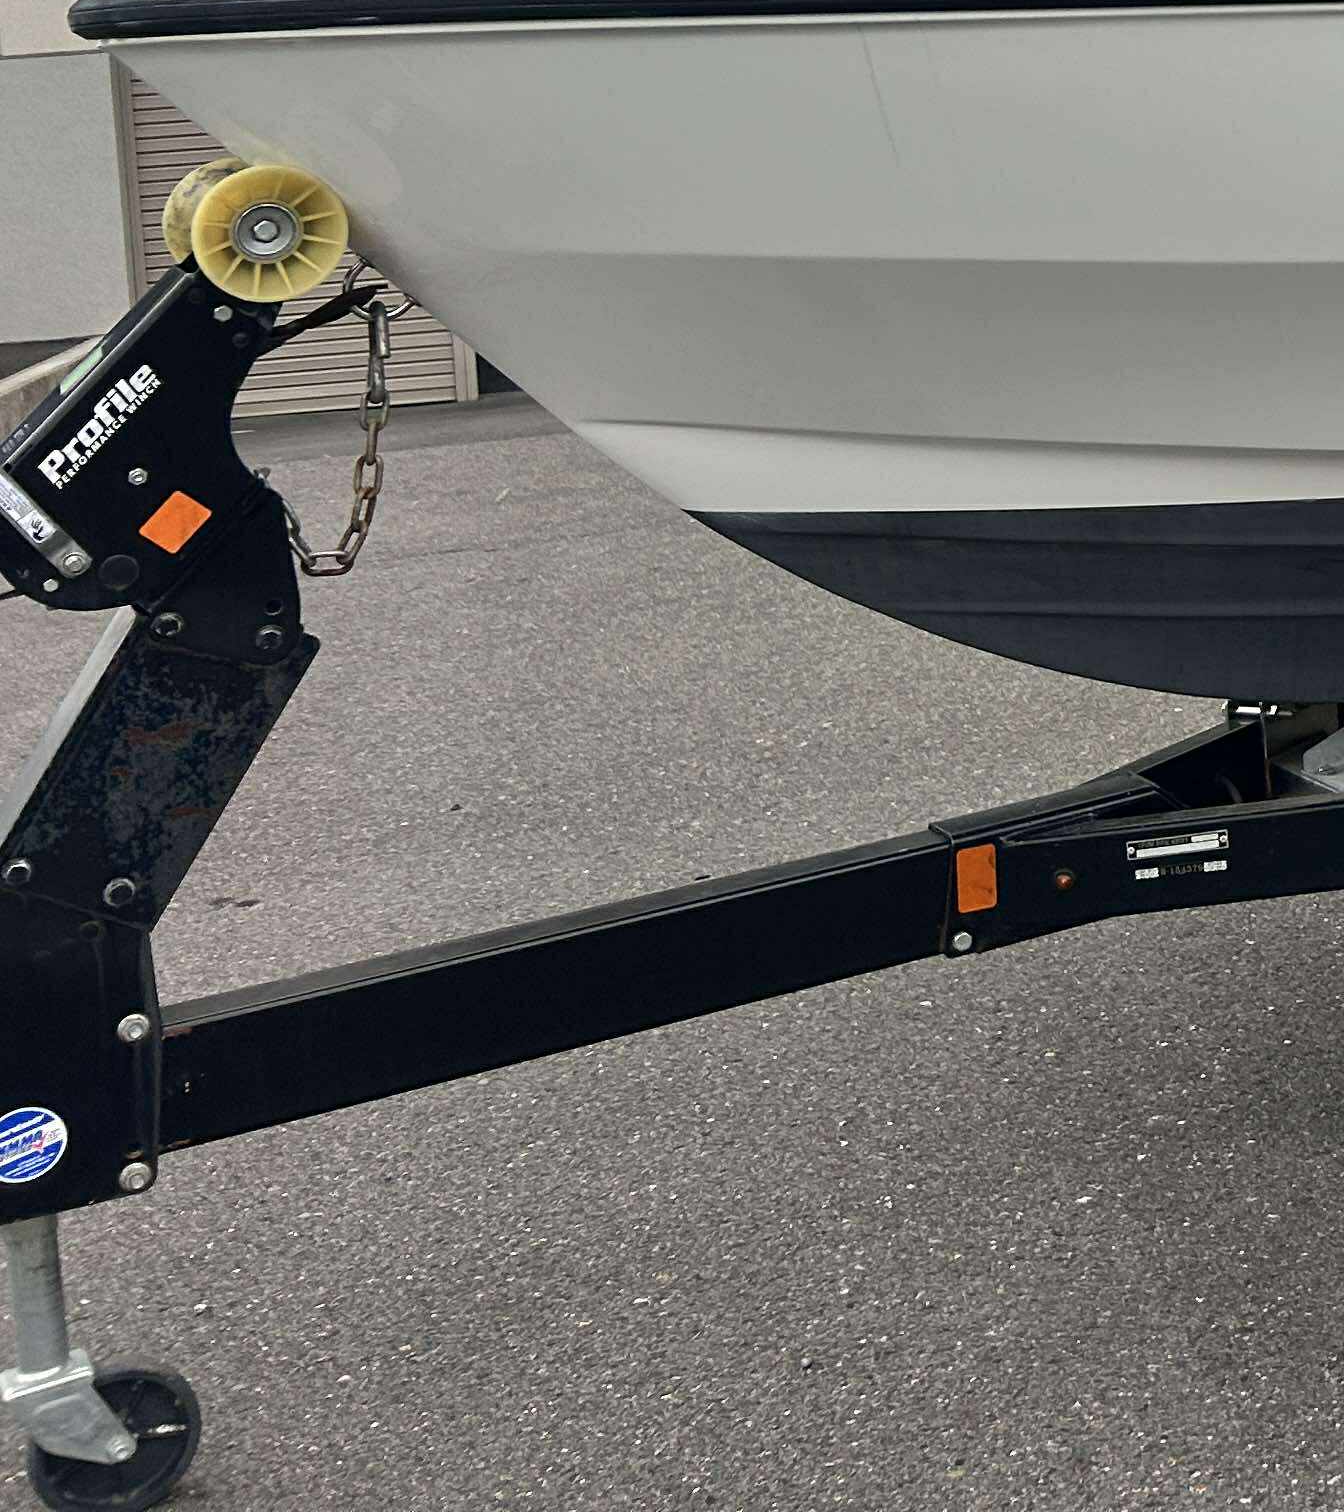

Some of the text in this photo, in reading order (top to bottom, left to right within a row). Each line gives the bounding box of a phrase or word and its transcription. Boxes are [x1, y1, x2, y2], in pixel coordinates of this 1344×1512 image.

[37, 364, 157, 485] Profile
[55, 376, 162, 490] PERFORMANCE WINCH
